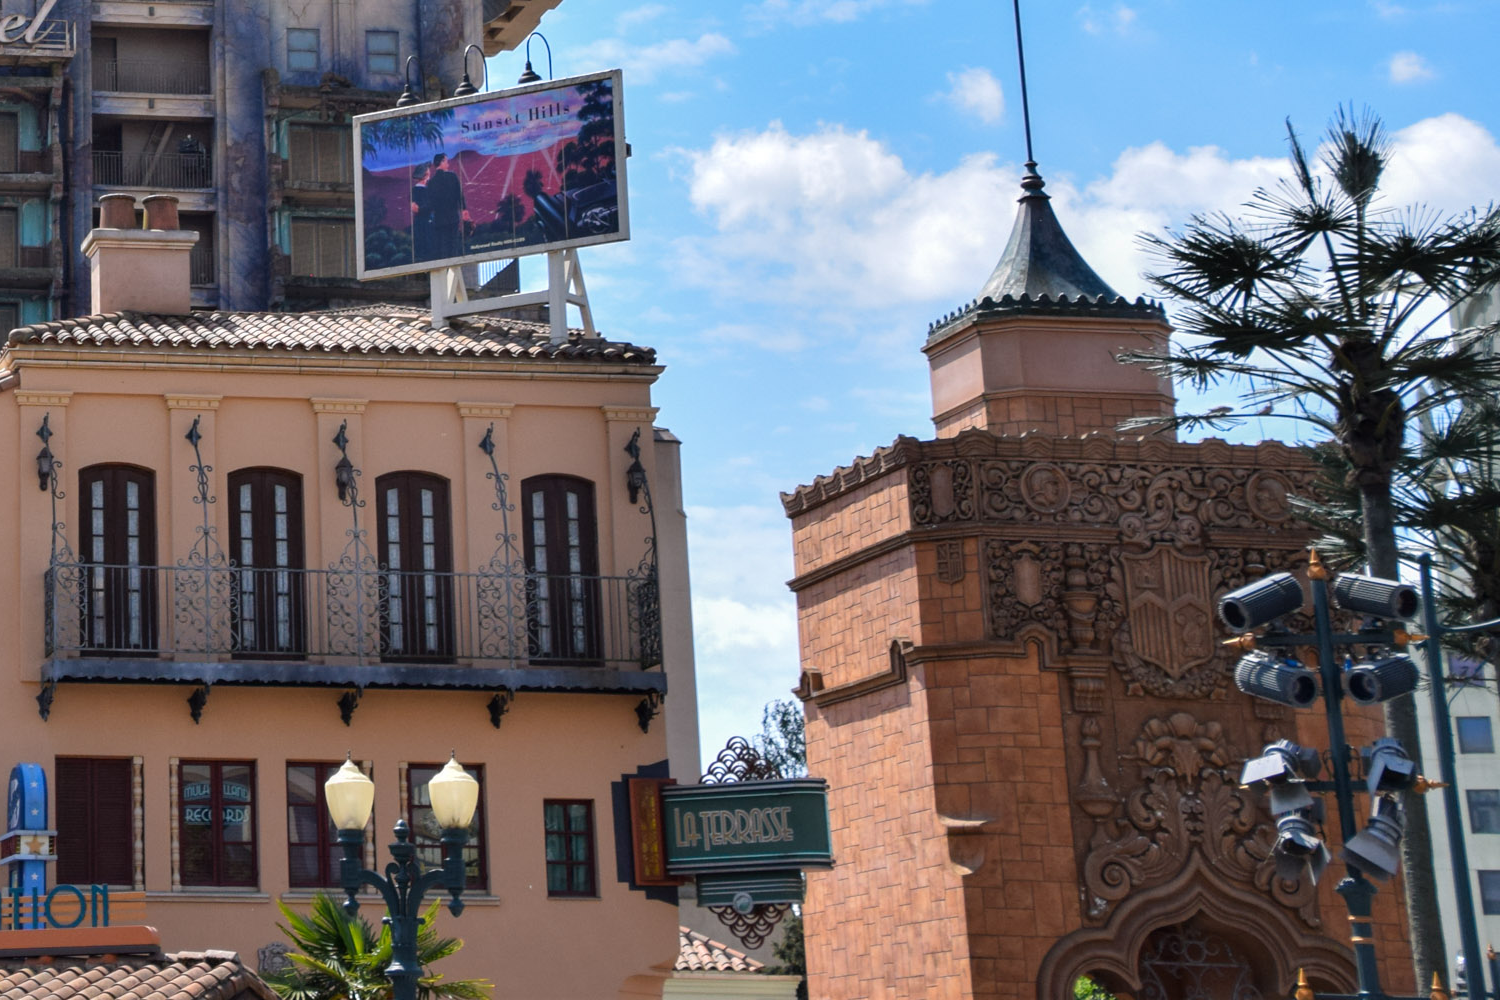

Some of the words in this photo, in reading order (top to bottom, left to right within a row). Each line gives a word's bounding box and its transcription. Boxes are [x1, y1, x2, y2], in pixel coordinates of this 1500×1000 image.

[461, 111, 520, 134] Sunset
[528, 102, 571, 122] Hills
[674, 807, 701, 848] LA
[699, 806, 794, 851] TERRASSE
